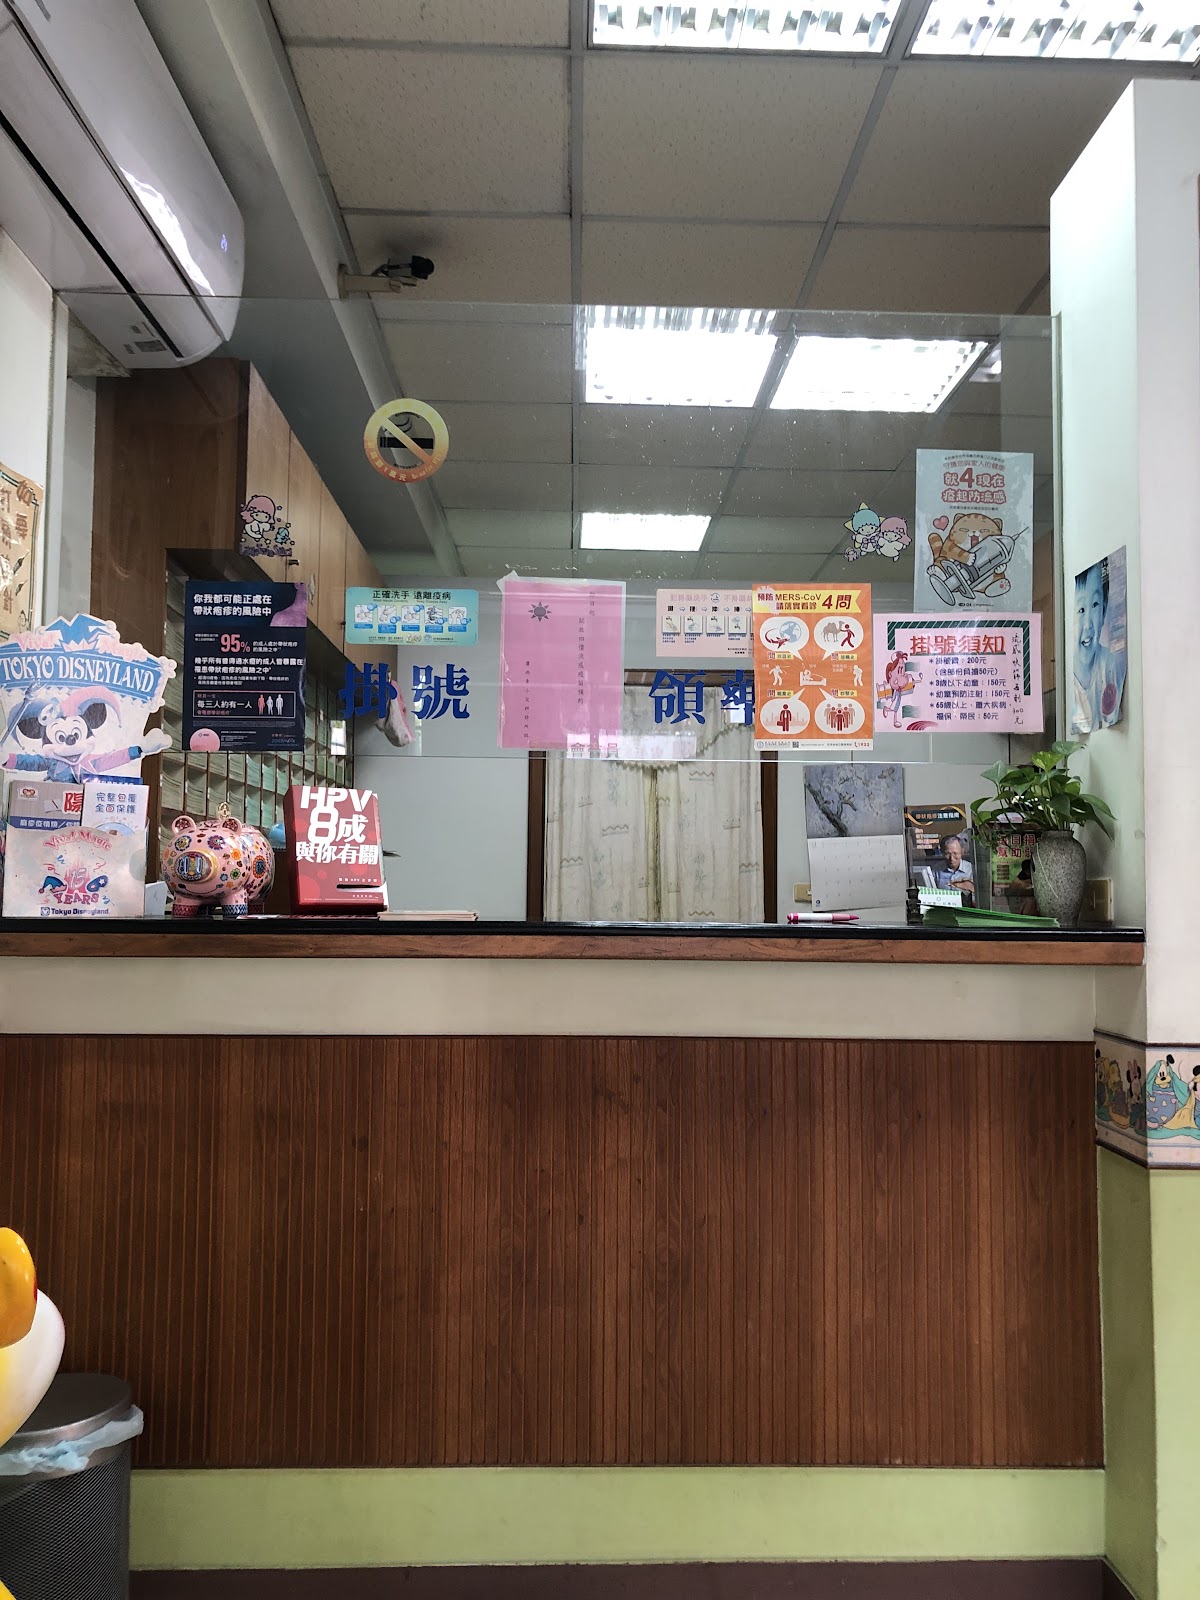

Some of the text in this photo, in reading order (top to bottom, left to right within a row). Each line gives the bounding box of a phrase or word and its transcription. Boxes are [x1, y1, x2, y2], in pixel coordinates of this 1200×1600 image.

[943, 467, 1005, 488] 就4現在
[941, 488, 1006, 504] 疫起防流感
[193, 594, 272, 605] 你我都可能正處在
[372, 590, 452, 601] 正確洗手 遠離疫病
[775, 593, 821, 601] MERS-CoV
[193, 606, 272, 617] 帶狀疱疹的風險中
[220, 634, 250, 652] 95%
[910, 635, 1006, 655] 掛號須知
[1, 655, 155, 693] TOKYO DISNEYLAND
[339, 662, 470, 720] 掛號
[197, 700, 252, 709] 每三人約有一人
[96, 792, 137, 802] 完整包覆
[300, 785, 373, 812] HPV
[95, 803, 136, 814] 全面保護
[308, 807, 369, 843] 8成
[79, 830, 112, 851] Magic
[296, 841, 379, 865] 與你有關
[53, 891, 100, 905] YEARS
[51, 908, 72, 916] Tokyo
